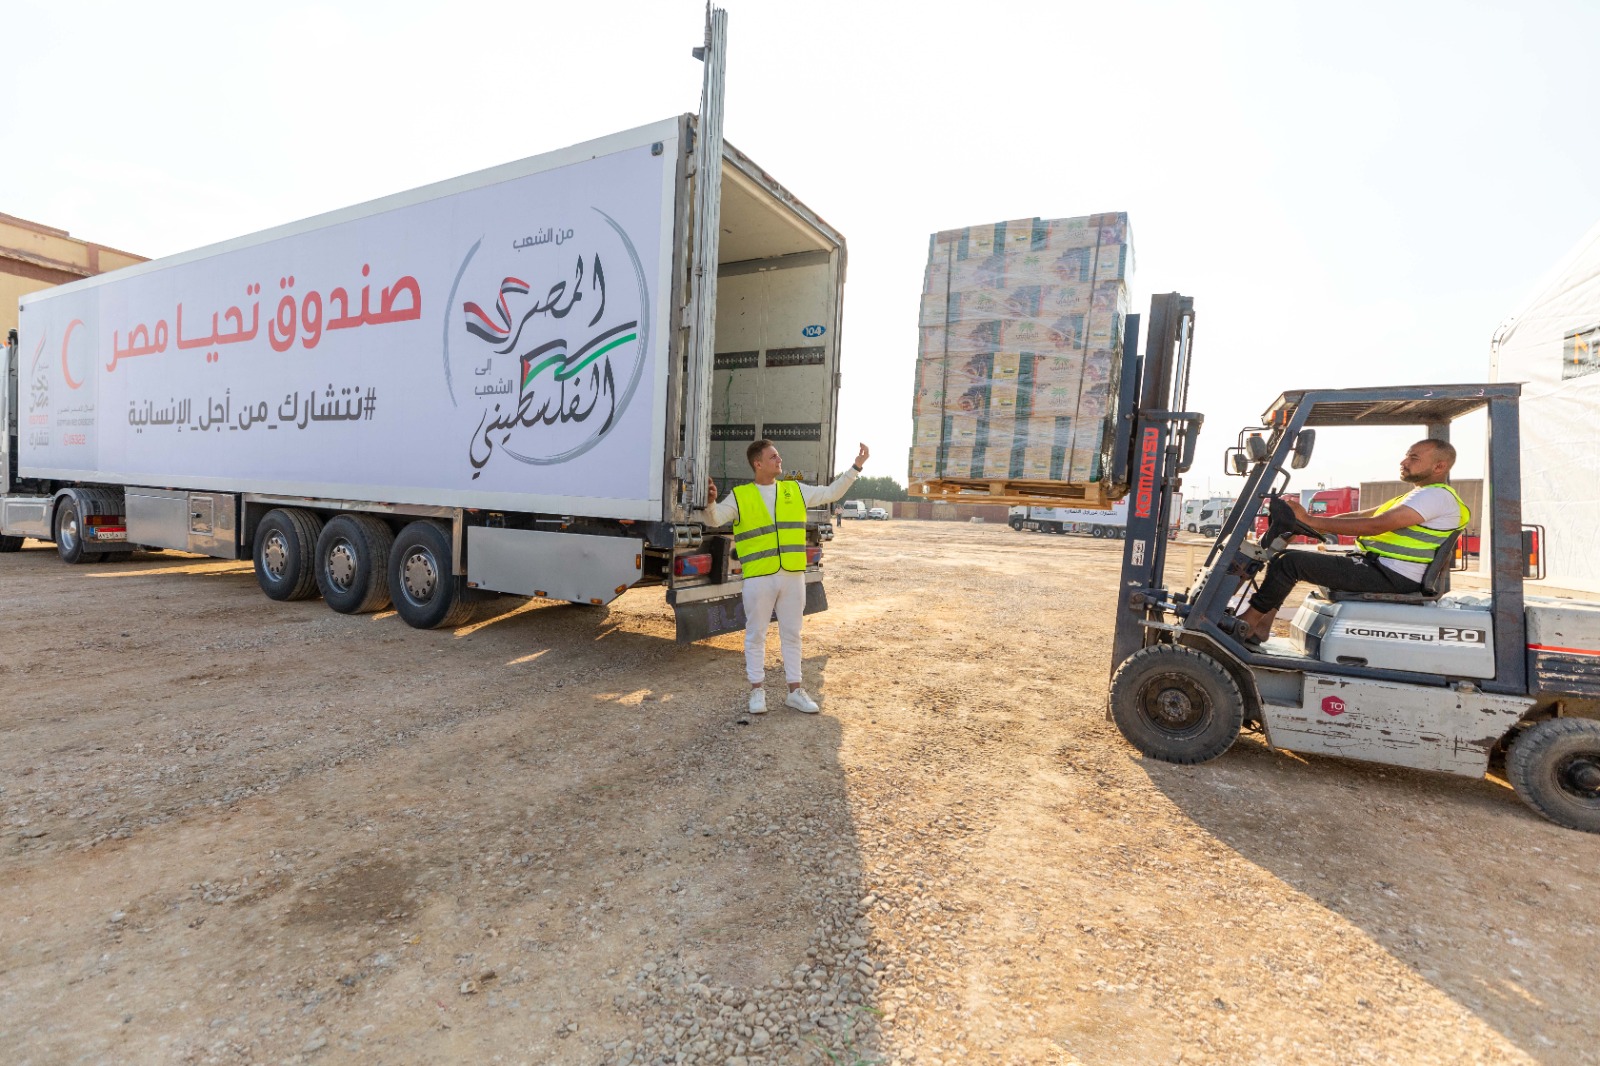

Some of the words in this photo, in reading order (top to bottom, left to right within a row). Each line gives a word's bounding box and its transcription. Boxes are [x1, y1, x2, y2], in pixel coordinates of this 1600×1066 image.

[512, 227, 553, 252] الشعب
[556, 228, 574, 245] من
[268, 263, 422, 353] صندوق
[176, 282, 261, 363] تحيا
[805, 326, 822, 337] 104
[105, 318, 169, 373] مصر
[475, 378, 513, 399] الشعب
[1135, 427, 1159, 518] KOMATSU
[1345, 627, 1434, 642] KOMATSU
[1443, 628, 1479, 643] 20
